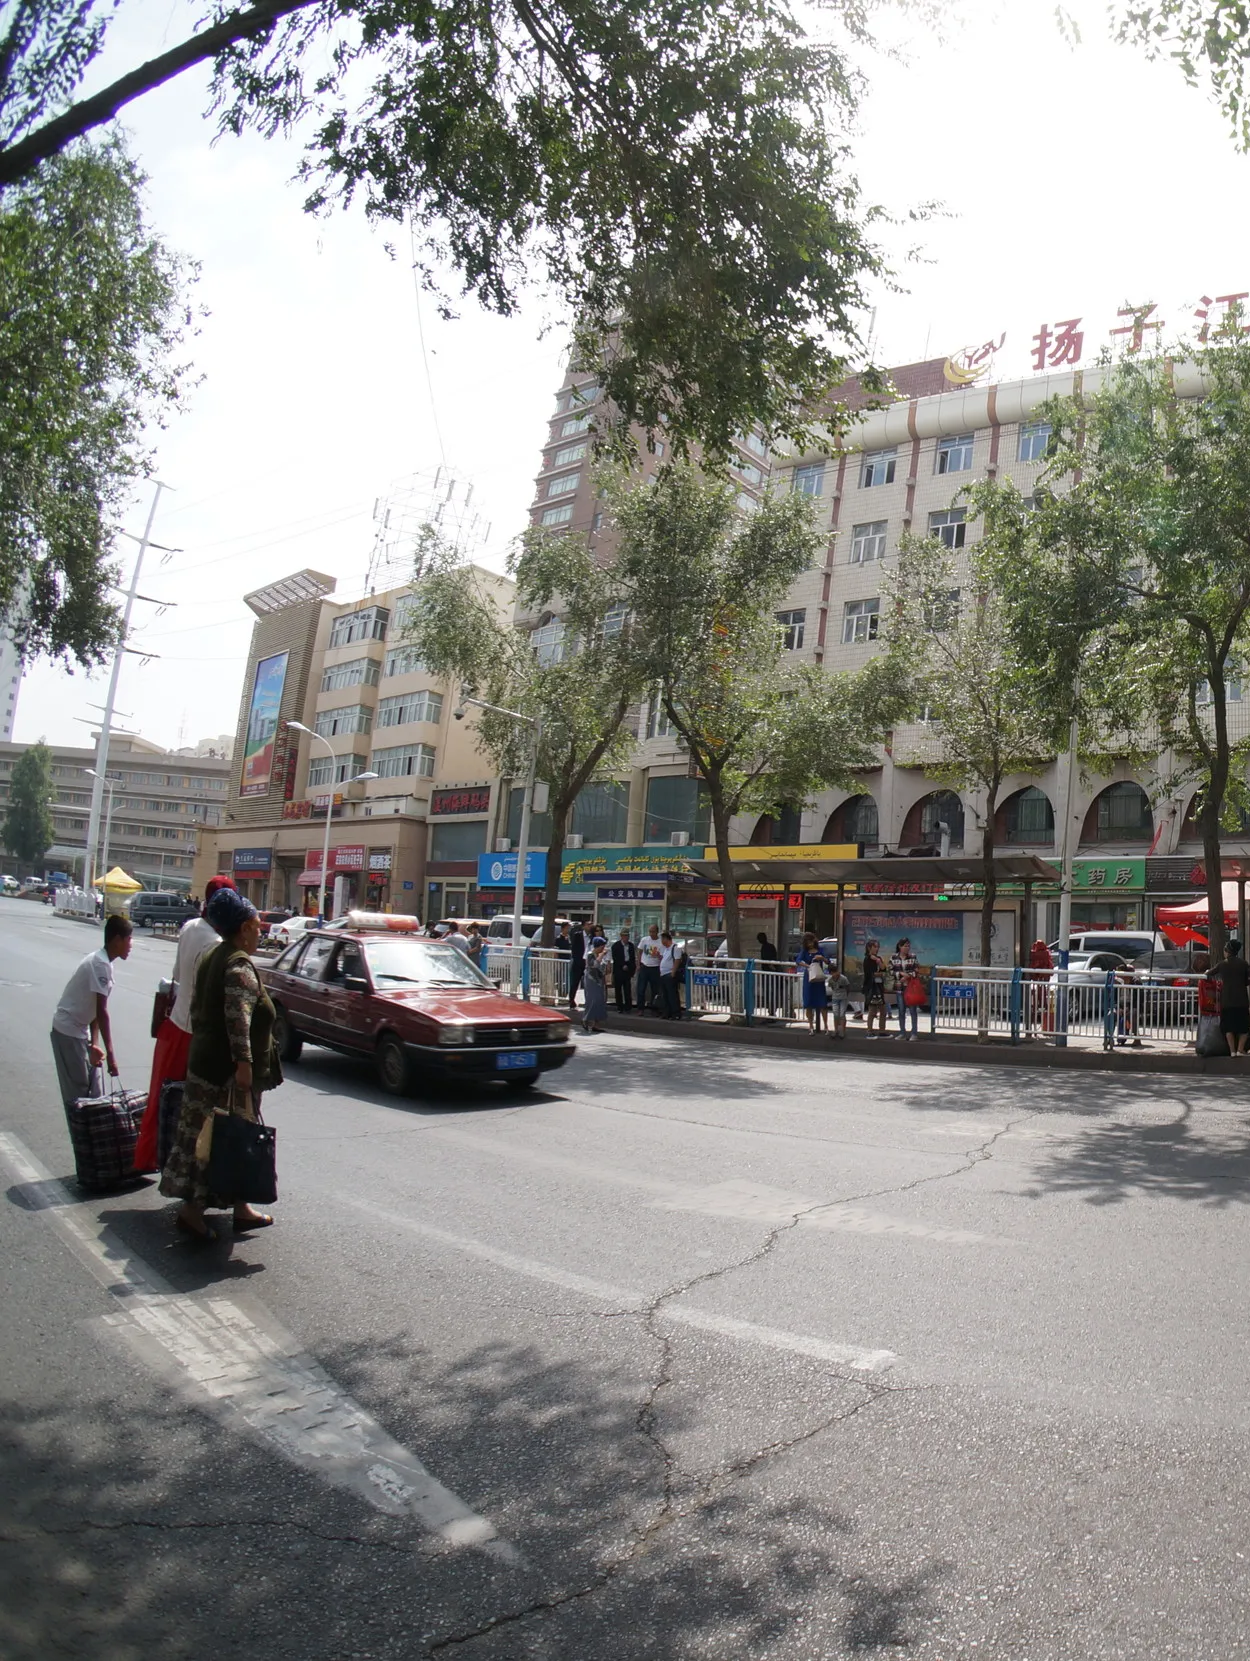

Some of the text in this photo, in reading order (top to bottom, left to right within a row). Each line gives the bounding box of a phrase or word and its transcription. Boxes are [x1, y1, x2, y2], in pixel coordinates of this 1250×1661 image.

[608, 890, 654, 898] 公交执勤点
